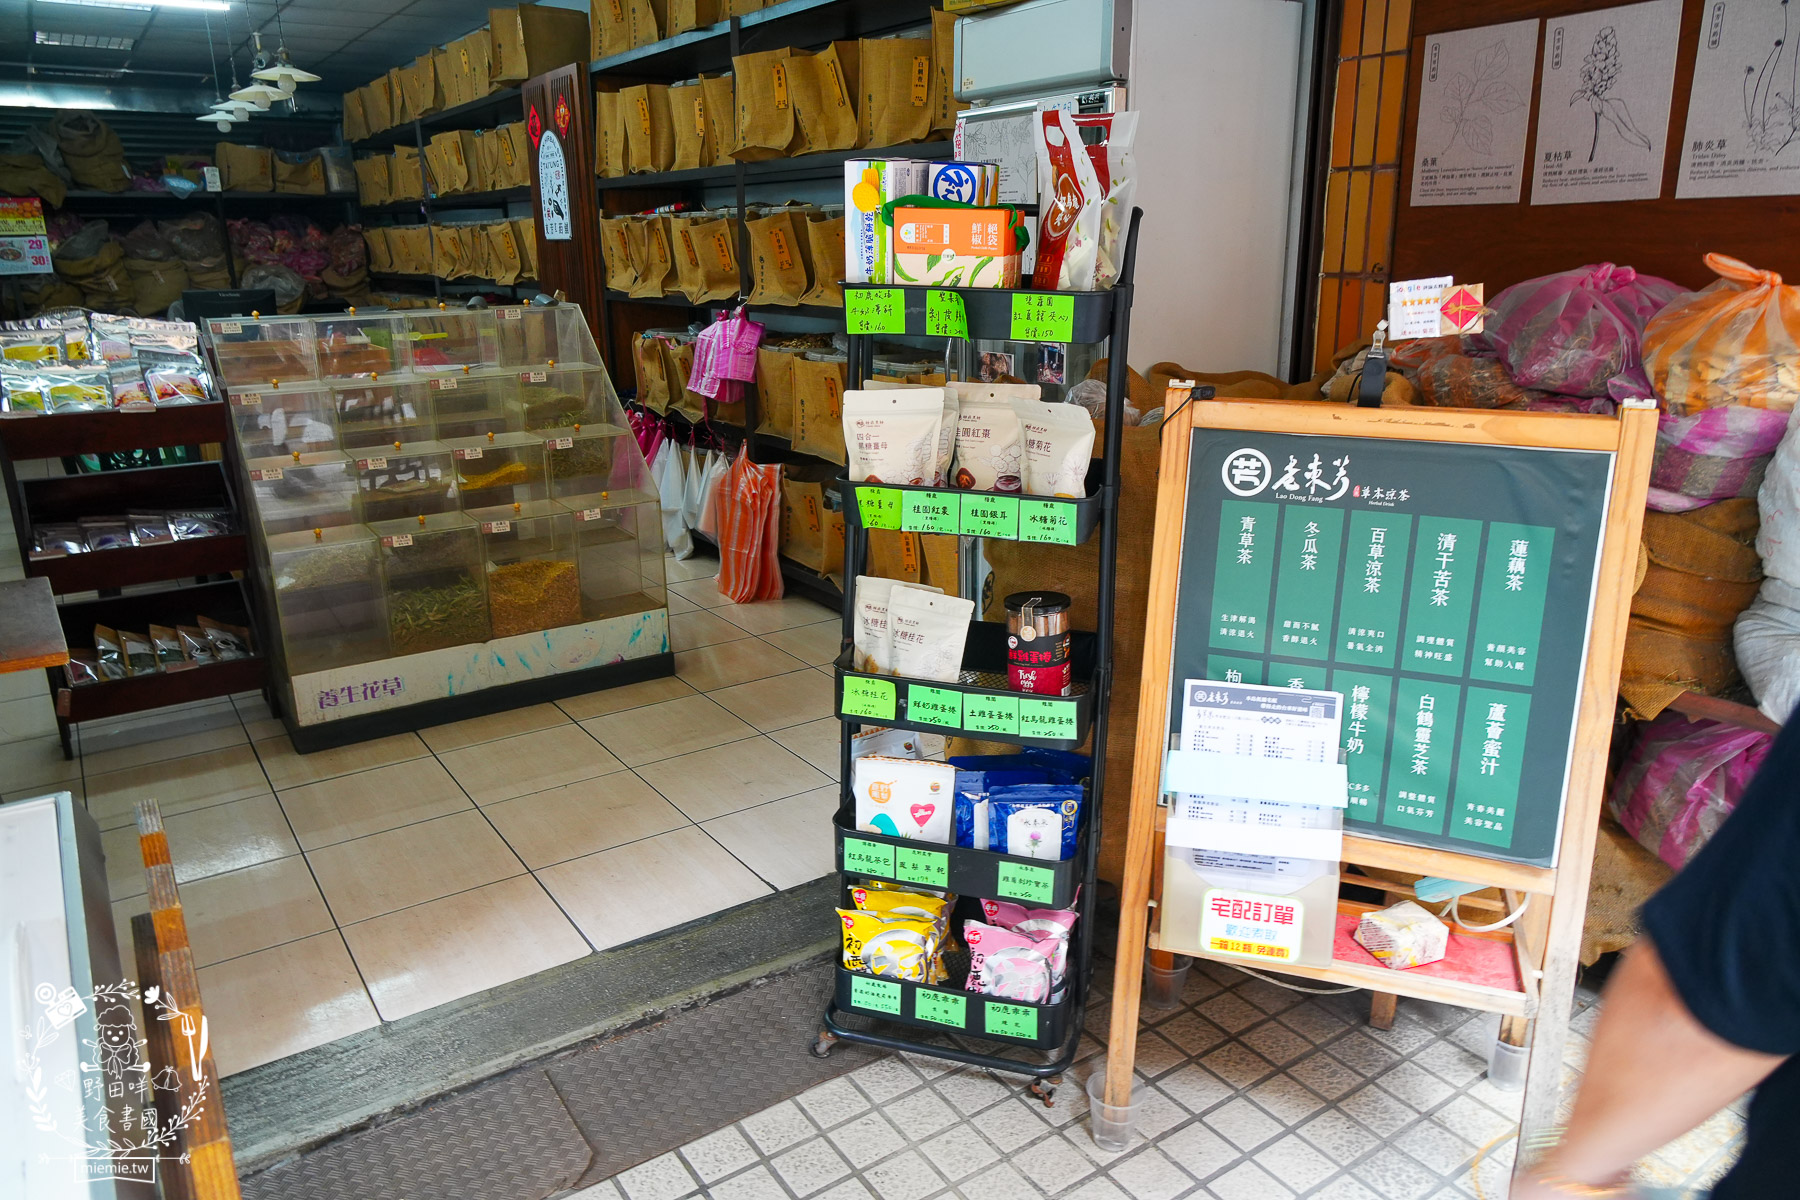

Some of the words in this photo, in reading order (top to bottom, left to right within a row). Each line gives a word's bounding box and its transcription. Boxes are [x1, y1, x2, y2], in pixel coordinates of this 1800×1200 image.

[1692, 139, 1726, 152] 肺炎草
[1422, 158, 1437, 167] 桑葉
[1544, 150, 1572, 162] 夏枯草
[28, 239, 43, 250] 29
[31, 255, 46, 266] 30
[858, 442, 888, 450] 黑糖薑母
[1272, 453, 1350, 500] 老東芳
[1289, 494, 1307, 502] Dong
[1308, 495, 1323, 503] Fang
[1361, 486, 1411, 502] 草本涼茶
[971, 509, 1007, 519] 桂圓銀耳
[1029, 515, 1068, 526] 冰糖菊花
[1236, 516, 1256, 564] 青草茶
[1300, 521, 1320, 570] 冬瓜茶
[1363, 528, 1388, 594] 百草涼茶
[1504, 540, 1529, 591] 蓮藕茶
[1429, 533, 1457, 606] 清干苦茶
[893, 628, 925, 644] 冰糖桂花
[1220, 628, 1255, 639] 清涼退火
[1348, 628, 1385, 638] 清涼爽口
[1416, 635, 1455, 647] 調理體質
[1346, 642, 1383, 654] 暑氣全消
[1487, 644, 1527, 656] 養顏美容
[1414, 650, 1453, 662] 精神旺盛
[1484, 658, 1525, 671] 幫助入眠
[1018, 669, 1037, 680] Fresh
[1225, 669, 1242, 684] 枸
[851, 688, 888, 700] 冰糖桂花
[1021, 715, 1074, 725] 紅烏龍雞蛋捲
[1346, 685, 1370, 754] 檸檬牛奶
[1410, 694, 1435, 775] 白鶴靈芝茶
[1480, 703, 1508, 776] 蘆薈蜜汁
[1347, 796, 1368, 806] 順暢
[1398, 790, 1436, 804] 調整體質
[1397, 805, 1435, 818] 口氣芬芳
[1466, 802, 1505, 816] 青春美麗
[848, 853, 891, 866] 紅烏龍茶包
[1211, 898, 1294, 925] 宅配訂單
[1225, 924, 1278, 941] 歡迎索取
[922, 991, 960, 1005] 初鹿乖乖
